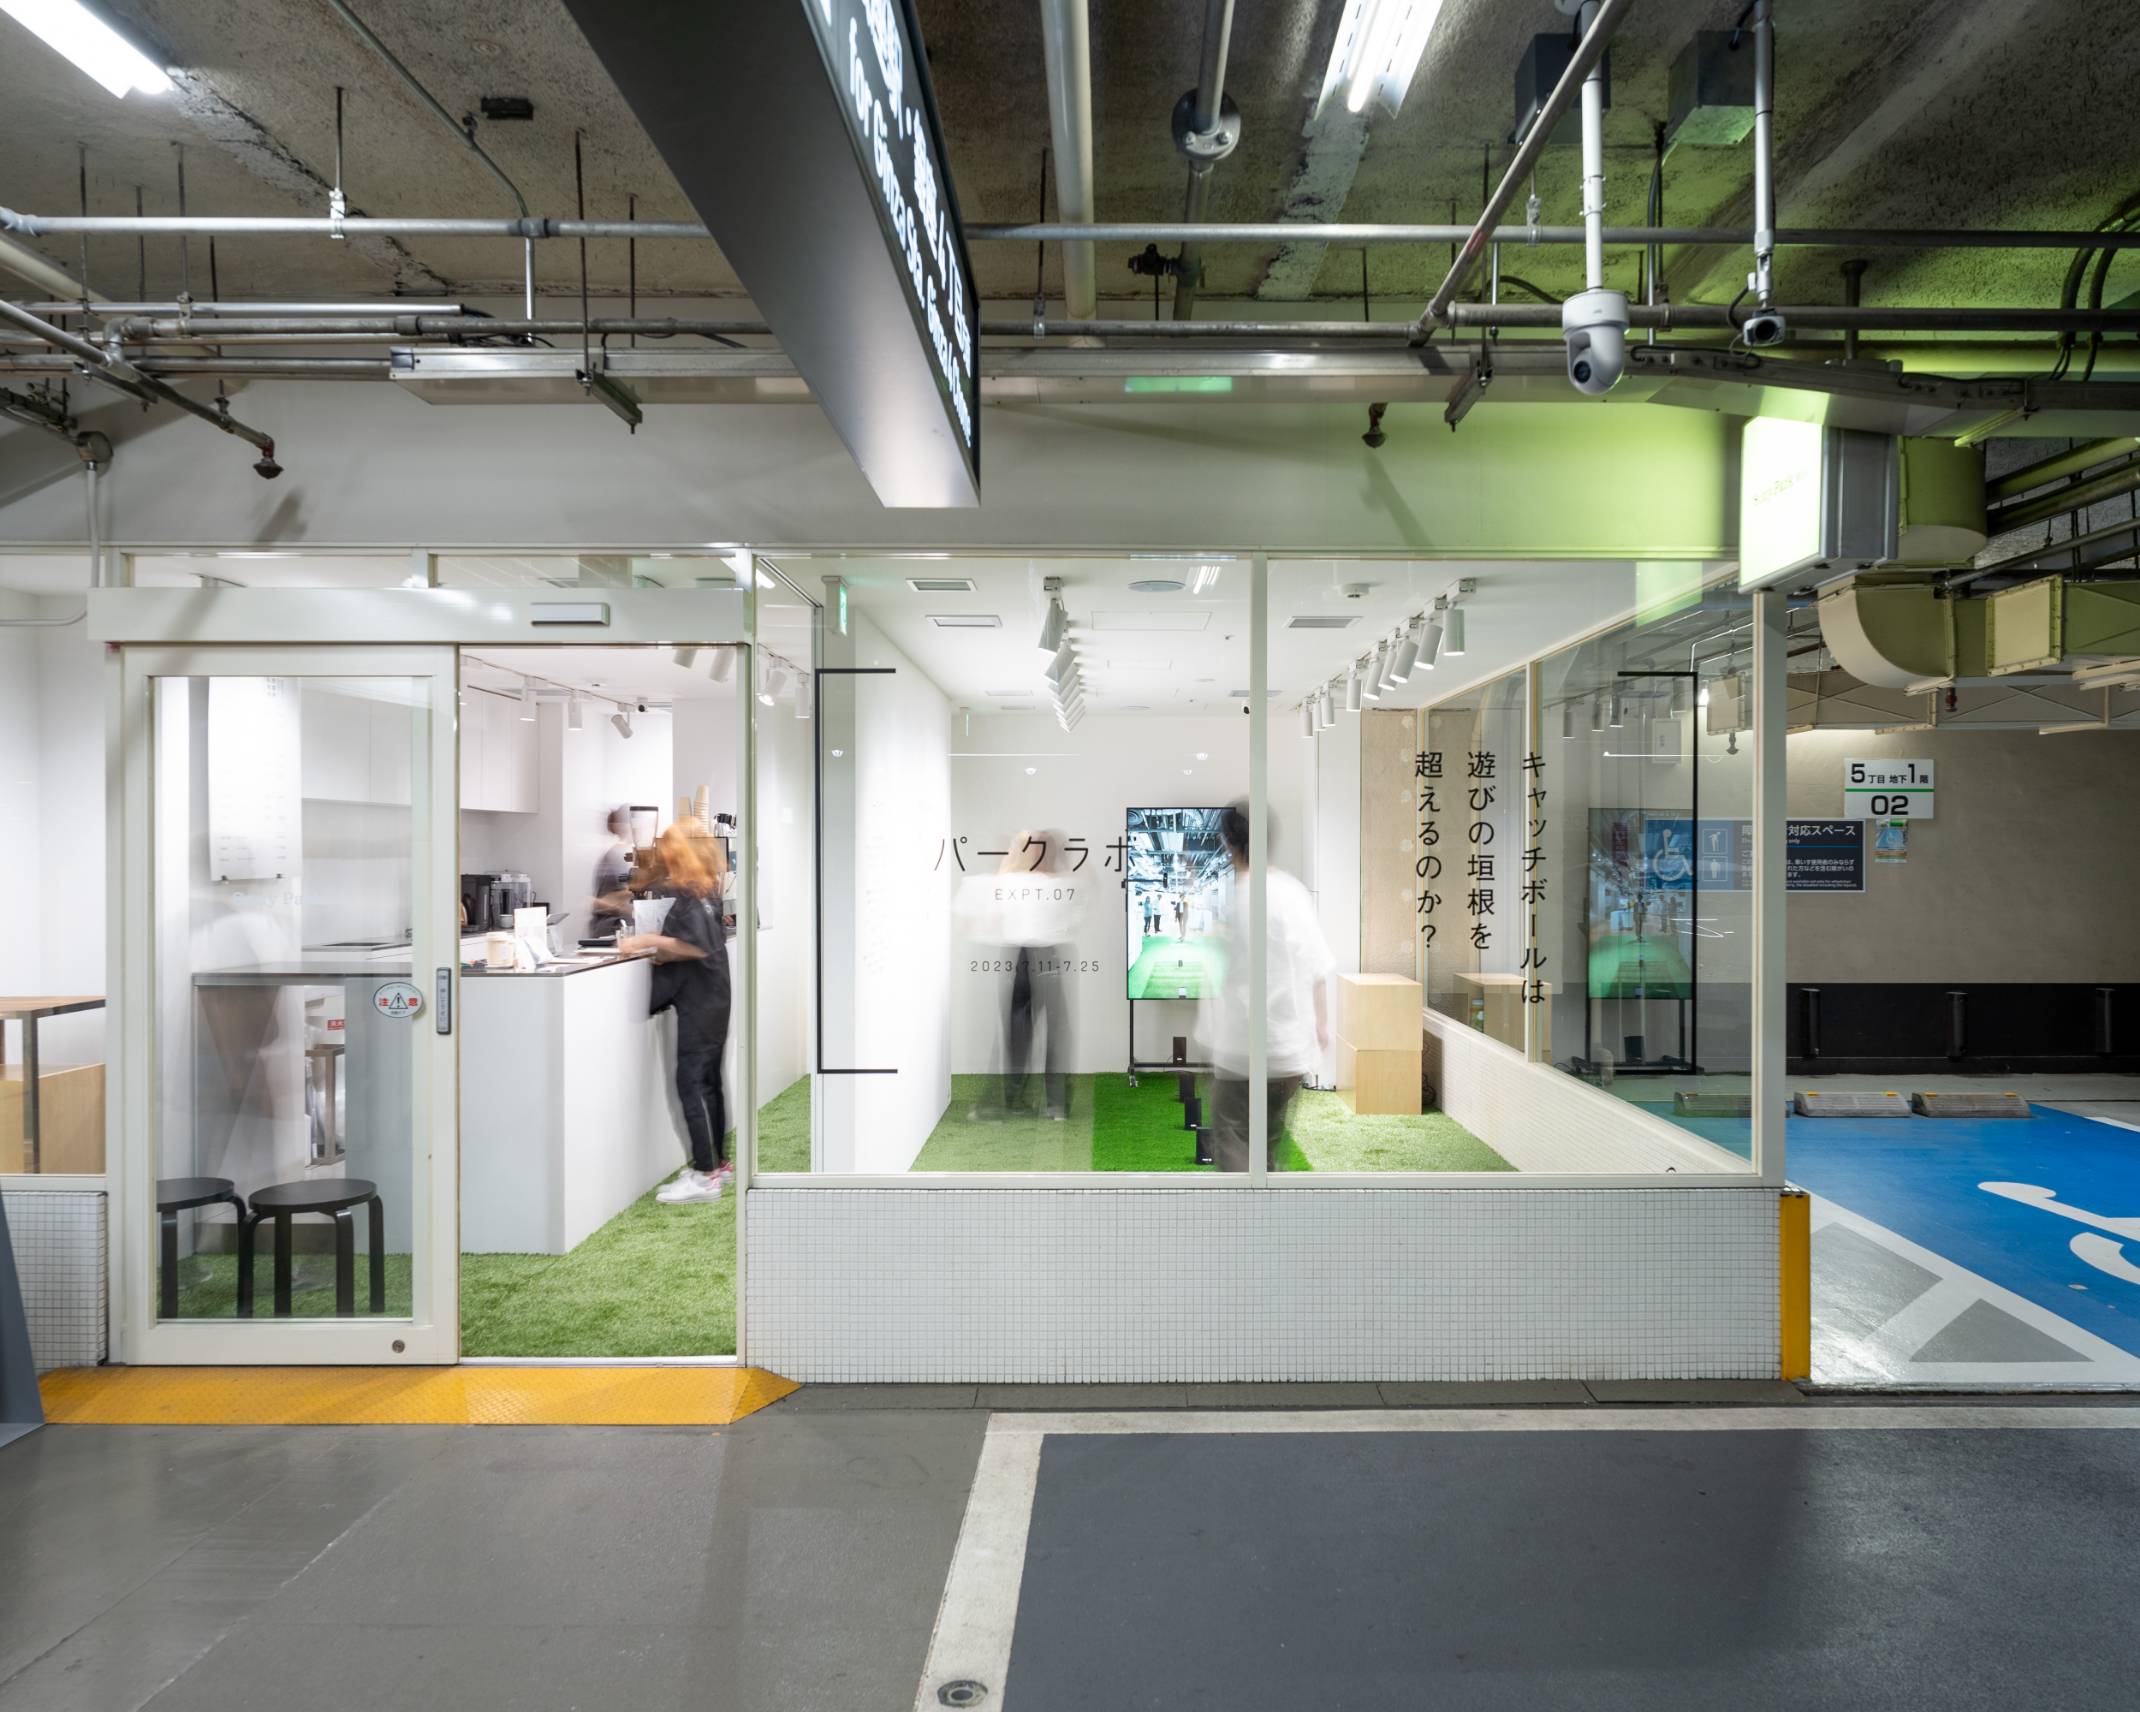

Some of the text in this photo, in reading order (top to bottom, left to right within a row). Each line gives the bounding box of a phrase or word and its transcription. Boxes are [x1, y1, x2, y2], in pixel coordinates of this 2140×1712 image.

[849, 17, 872, 138] for
[873, 99, 906, 252] Ginza
[906, 206, 925, 310] Sta.
[927, 275, 948, 379] Ginza
[1415, 751, 1443, 948] 超えるのか？
[1467, 751, 1496, 950] 遊びの垣根を
[1851, 763, 1929, 784] 5丁目 地下1階
[1871, 795, 1909, 815] 02
[994, 888, 1075, 901] EXPT.07
[1520, 752, 1547, 1004] キャッチボールは
